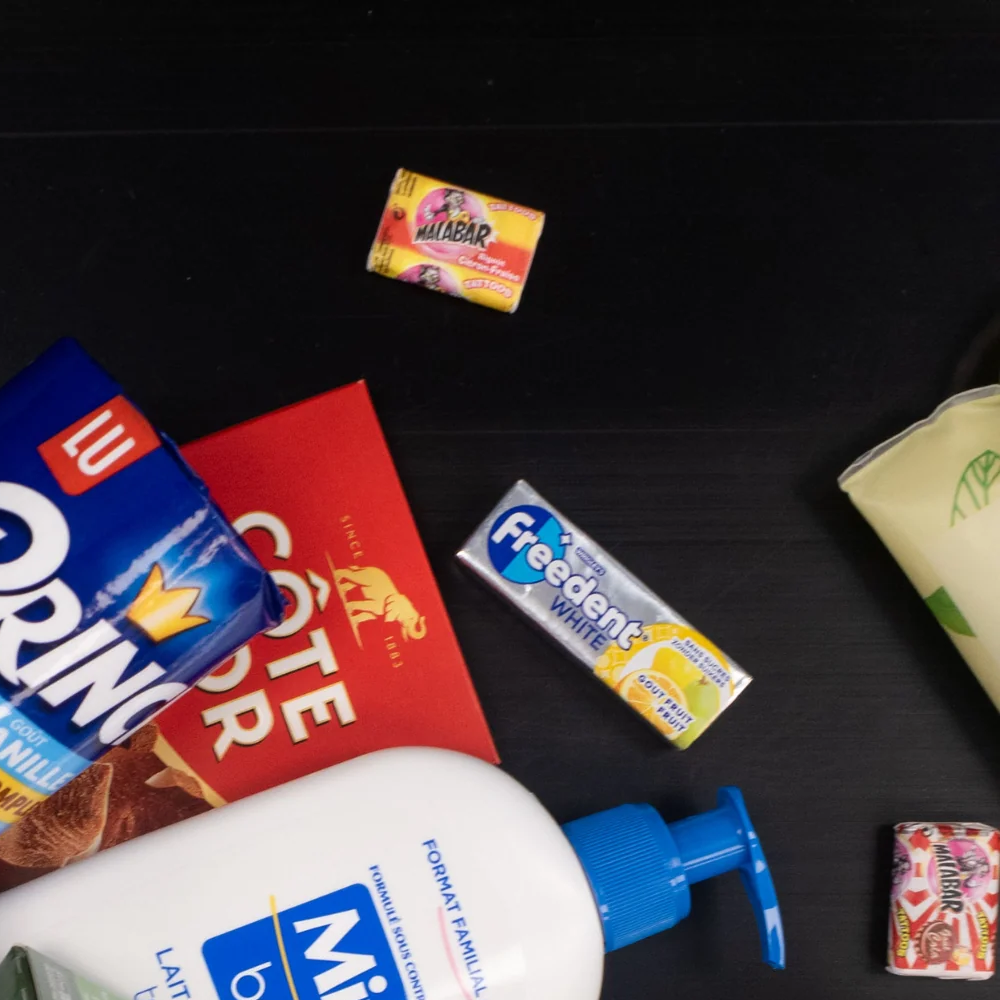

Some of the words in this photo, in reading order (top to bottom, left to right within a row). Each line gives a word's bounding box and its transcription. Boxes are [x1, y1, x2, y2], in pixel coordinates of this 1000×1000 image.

[413, 221, 493, 248] MALABAR
[61, 409, 136, 477] LU
[339, 514, 365, 559] SINCE
[490, 511, 643, 651] Freedent
[232, 511, 357, 745] CÔTE
[550, 596, 627, 651] WHITE
[384, 635, 405, 669] 1883
[684, 638, 706, 662] SANS
[702, 655, 731, 682] SUCRES
[9, 717, 49, 748] GOÛT
[655, 706, 687, 733] FRUIT
[663, 698, 694, 724] FRUIT
[932, 843, 964, 914] MALABAR
[368, 864, 399, 926] FORMULÉ
[390, 924, 411, 961] SOUS
[421, 838, 462, 912] FORMAT
[450, 916, 489, 999] FAMILIAL
[154, 947, 191, 1000] LAIT
